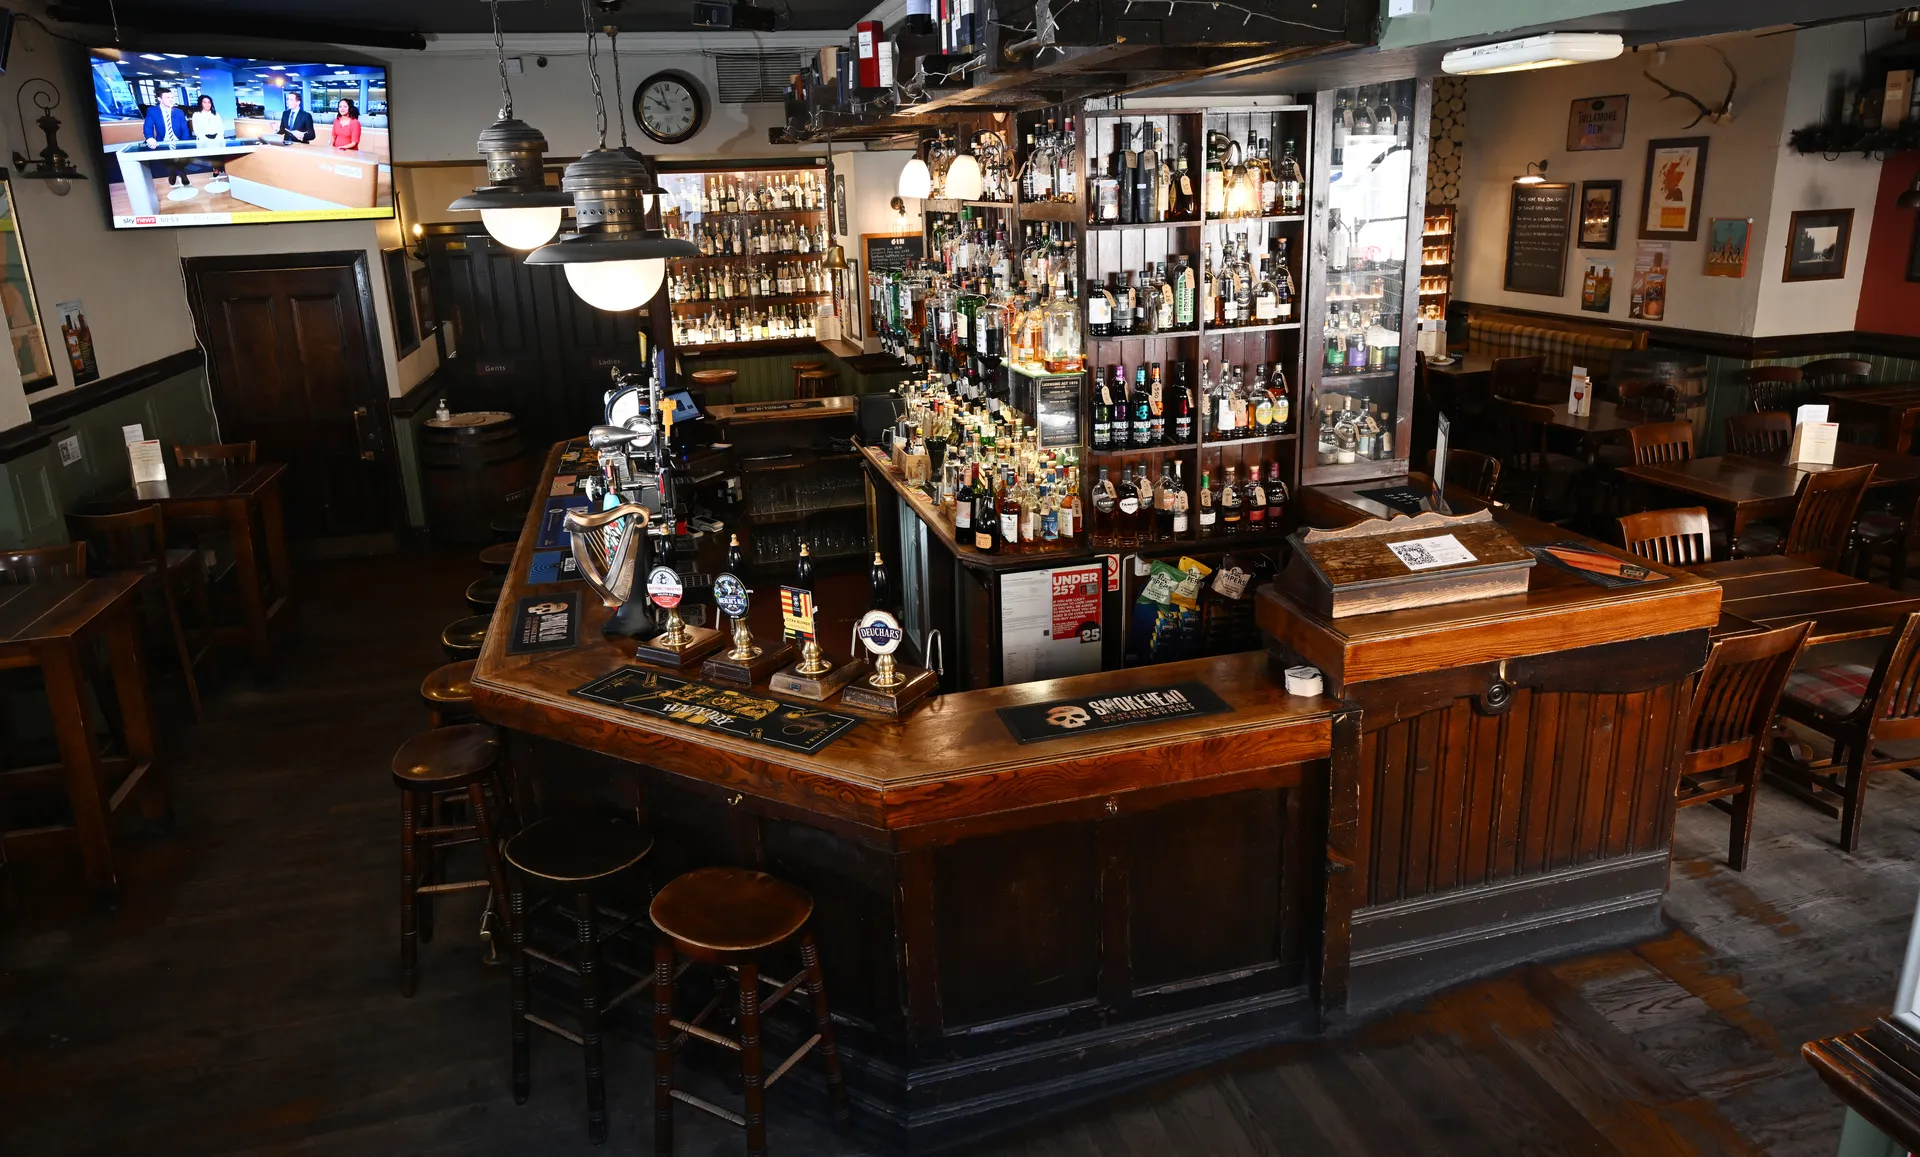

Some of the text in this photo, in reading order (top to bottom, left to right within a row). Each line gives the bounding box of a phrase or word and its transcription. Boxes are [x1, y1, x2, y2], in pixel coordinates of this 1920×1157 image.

[1578, 110, 1617, 124] TULLAMORE
[1588, 124, 1604, 134] DEW
[1053, 572, 1098, 586] UNDER
[1222, 573, 1246, 587] PIPERS
[1053, 585, 1076, 596] 25?
[861, 628, 900, 639] DEUCHARS
[1082, 628, 1100, 640] 25
[1088, 689, 1188, 716] SMOKEHEAD
